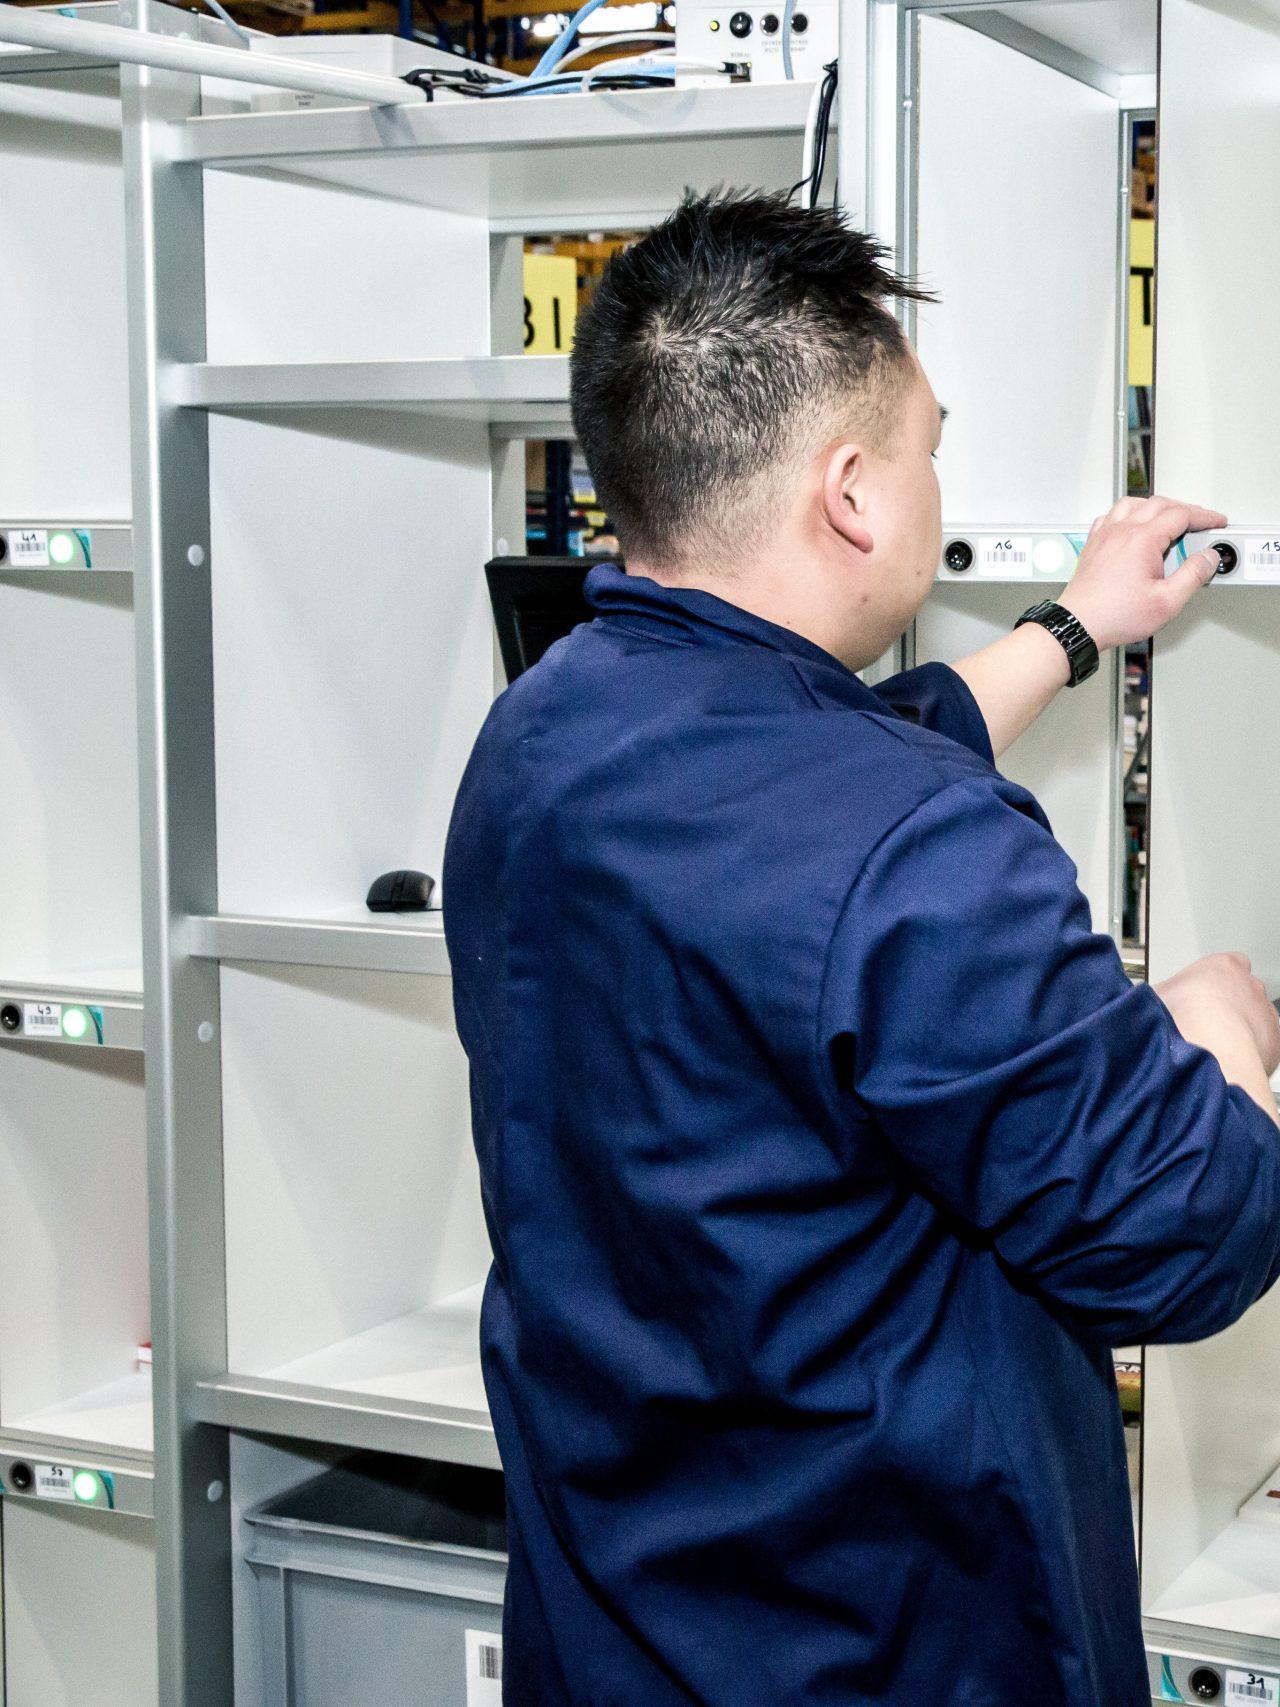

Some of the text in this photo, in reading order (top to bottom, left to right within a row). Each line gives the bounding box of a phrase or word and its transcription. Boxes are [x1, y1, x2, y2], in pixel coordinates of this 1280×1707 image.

[995, 540, 1013, 550] 16
[1261, 541, 1280, 552] 15
[1246, 1673, 1265, 1689] 31
